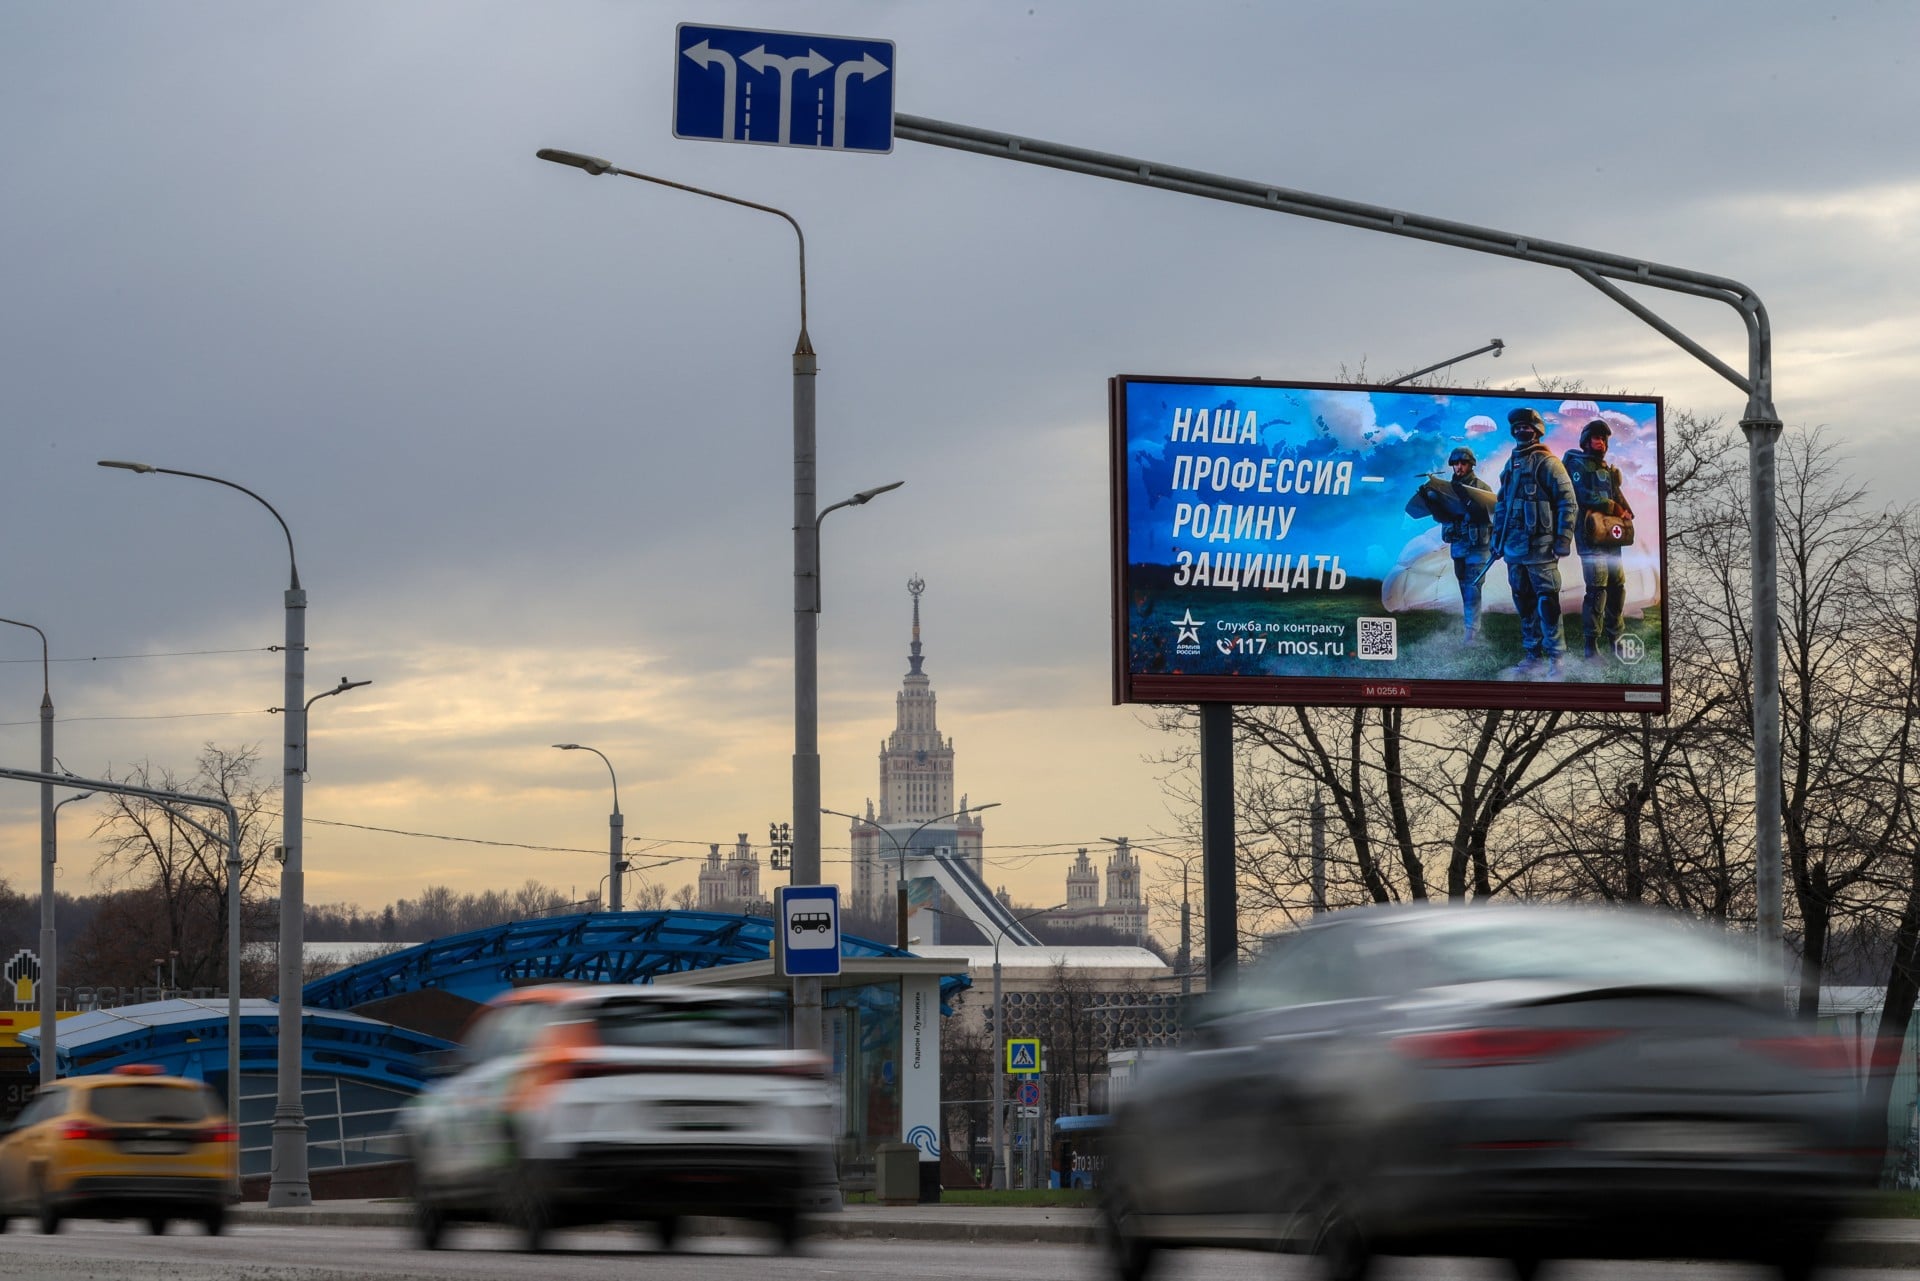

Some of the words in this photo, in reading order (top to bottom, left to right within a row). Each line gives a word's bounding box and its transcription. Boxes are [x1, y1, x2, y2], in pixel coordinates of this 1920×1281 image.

[1171, 407, 1257, 445] НАША
[1171, 455, 1353, 496] ПРОФЕССИЯ
[1172, 503, 1296, 544] РОДИНУ
[1173, 550, 1347, 593] ЗАЩИЩАТЬ
[1216, 619, 1261, 632] Служба
[1265, 623, 1280, 632] по
[1283, 624, 1345, 636] контракту
[1235, 638, 1267, 655] 117
[1277, 639, 1344, 656] mos.ru
[1620, 639, 1642, 659] 18+
[1376, 687, 1398, 695] 0256
[913, 1038, 921, 1069] Стадион
